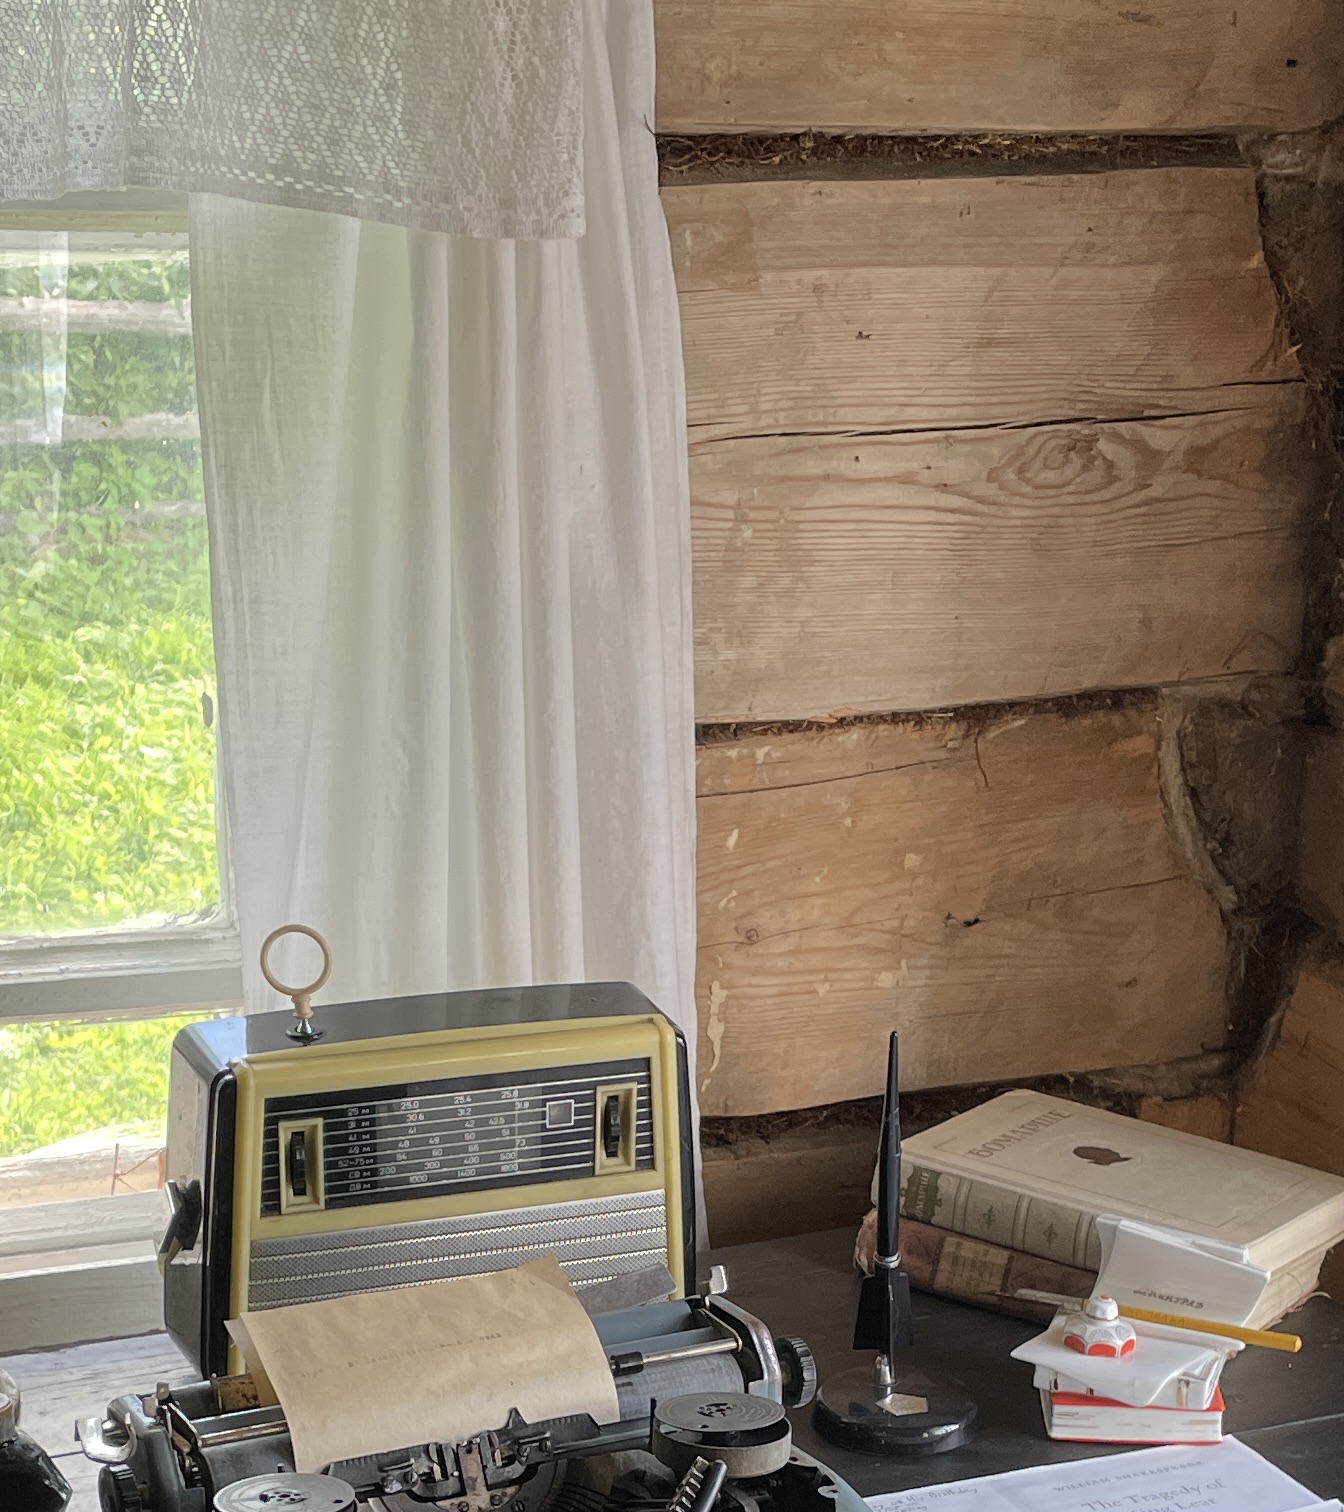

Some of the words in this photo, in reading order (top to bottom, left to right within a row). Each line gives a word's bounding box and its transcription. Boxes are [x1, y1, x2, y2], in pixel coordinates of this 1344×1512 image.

[967, 1109, 1073, 1158] БОМАРШЕ
[1052, 1477, 1111, 1492] WILLIAM
[1081, 1499, 1123, 1512] The
[1123, 1484, 1202, 1505] Tragedy
[1206, 1478, 1225, 1490] of
[1176, 1498, 1217, 1511] Lear
